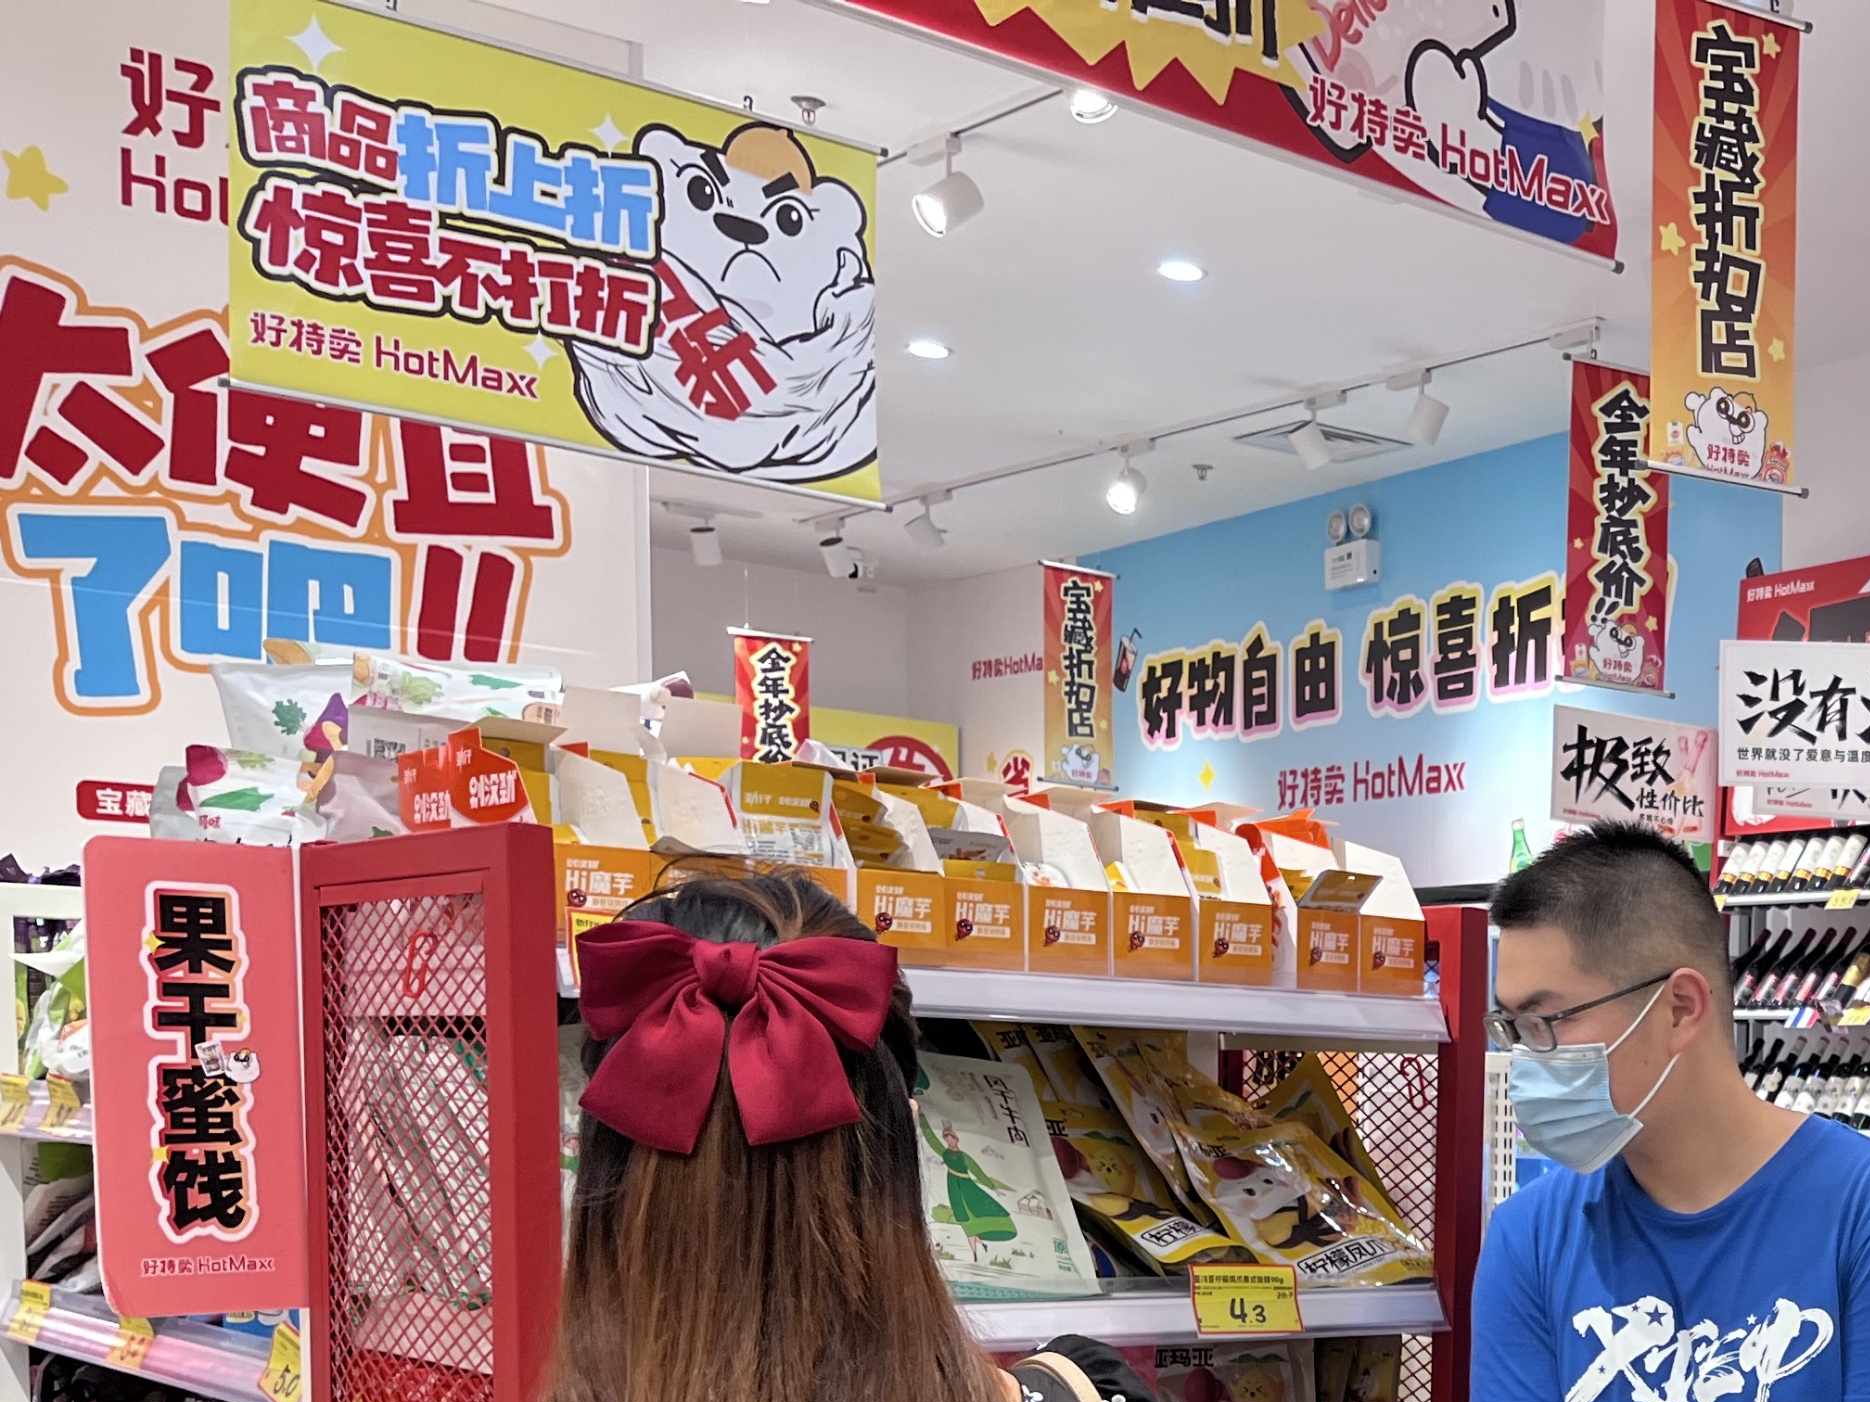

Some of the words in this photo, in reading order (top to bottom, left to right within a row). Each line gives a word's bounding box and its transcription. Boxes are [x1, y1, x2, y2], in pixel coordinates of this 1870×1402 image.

[249, 76, 655, 254] 商品折上折
[1308, 75, 1429, 160] 好特卖
[1440, 123, 1609, 224] HotMaxx
[1691, 23, 1762, 380] 宝藏折扣店
[252, 187, 649, 347] 惊喜不打折
[250, 312, 362, 364] 好特卖
[375, 336, 538, 401] HotMaxx
[1062, 579, 1096, 737] 宝藏折扣店
[1141, 632, 1337, 741] 好物自由
[1366, 577, 1569, 706] 惊喜折
[1277, 766, 1344, 811] 好特卖
[1353, 755, 1466, 803] HotMaxx
[1560, 724, 1675, 812] 极致
[1636, 788, 1704, 818] 性价比
[155, 894, 247, 1230] 果干蜜饯
[1229, 1298, 1267, 1324] 4.3
